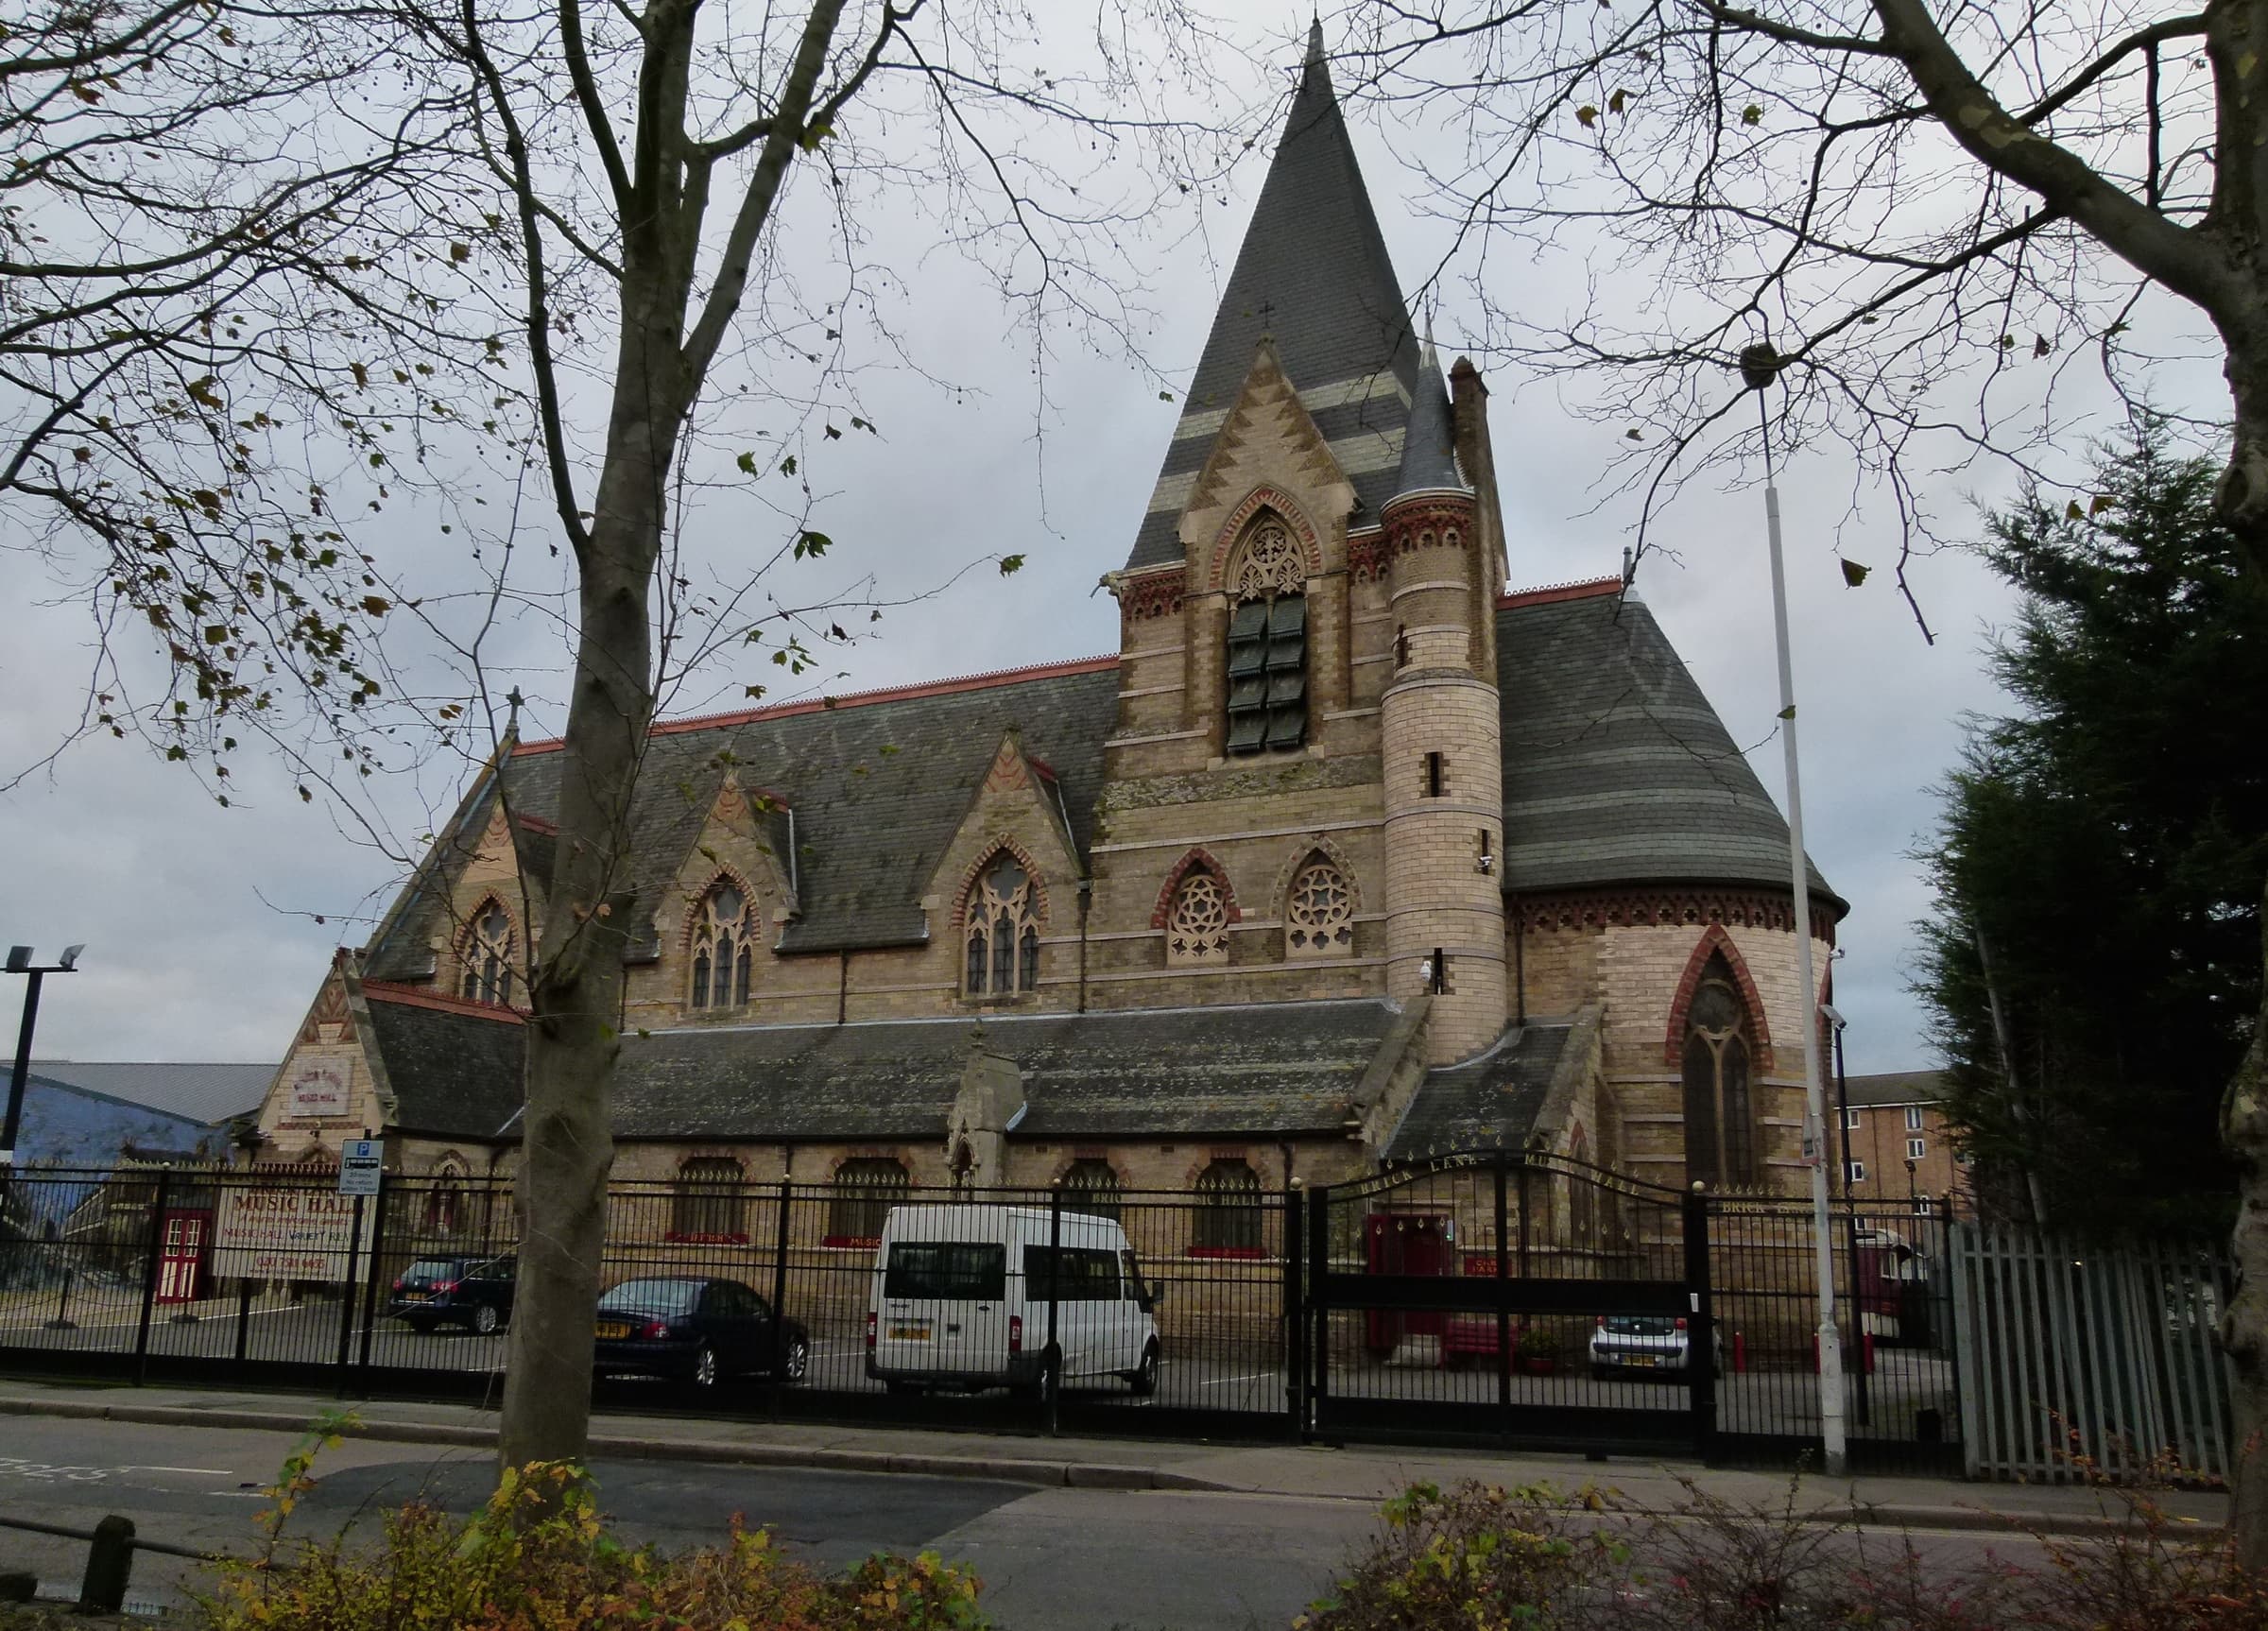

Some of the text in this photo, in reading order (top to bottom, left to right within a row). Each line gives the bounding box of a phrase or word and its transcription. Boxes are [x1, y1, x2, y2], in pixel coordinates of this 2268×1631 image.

[1361, 1170, 1413, 1194] BRICK
[1430, 1155, 1477, 1173] LANE
[828, 1187, 909, 1200] RICK LAN
[1092, 1193, 1124, 1204] BRIC
[1221, 1194, 1260, 1206] HALL
[233, 1195, 298, 1211] MUSIC
[1723, 1201, 1764, 1213] BRICK
[224, 1228, 258, 1239] MUSIC
[850, 1238, 882, 1246] MUSIC
